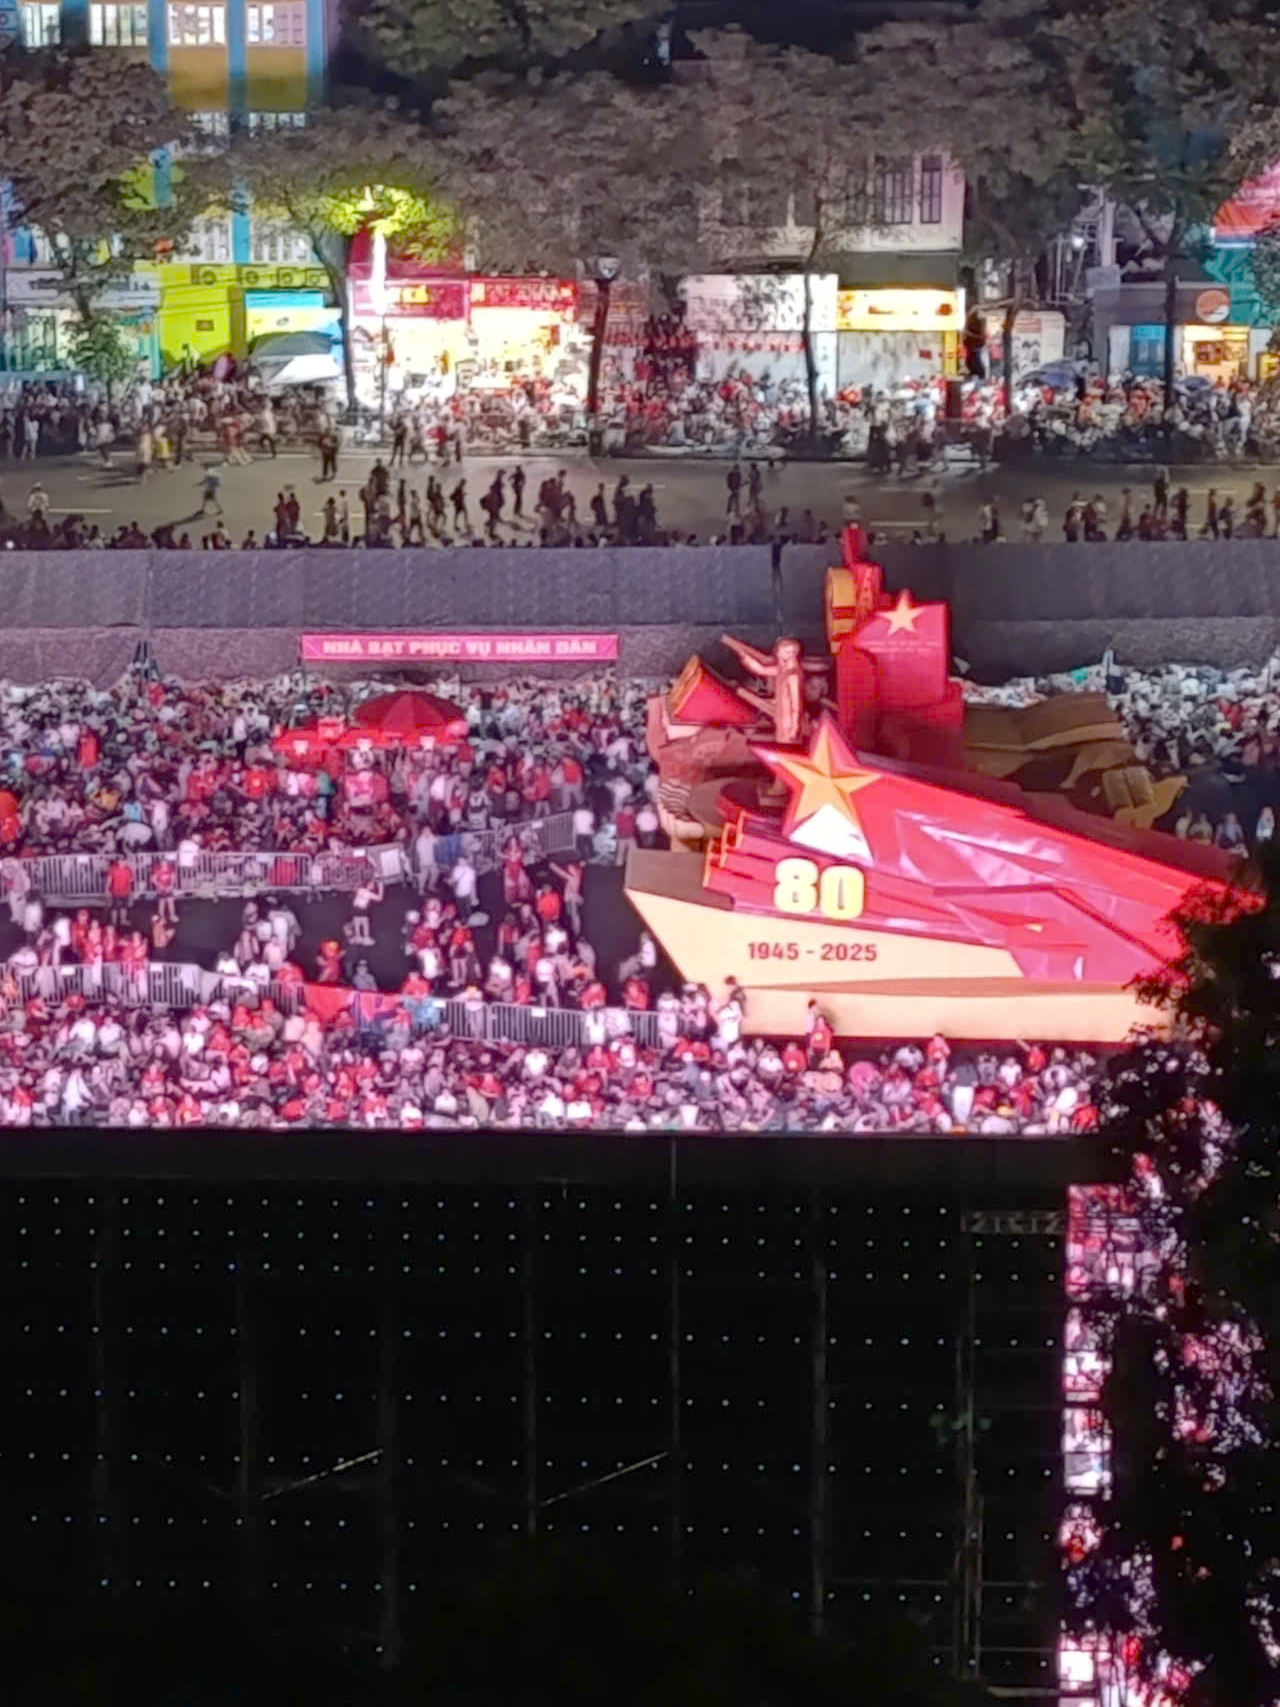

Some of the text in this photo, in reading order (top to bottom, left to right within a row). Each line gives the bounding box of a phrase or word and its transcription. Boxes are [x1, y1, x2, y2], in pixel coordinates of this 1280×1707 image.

[465, 640, 491, 659] VỤ
[773, 857, 865, 920] 80
[747, 941, 799, 961] 1945
[820, 942, 878, 962] 2025
